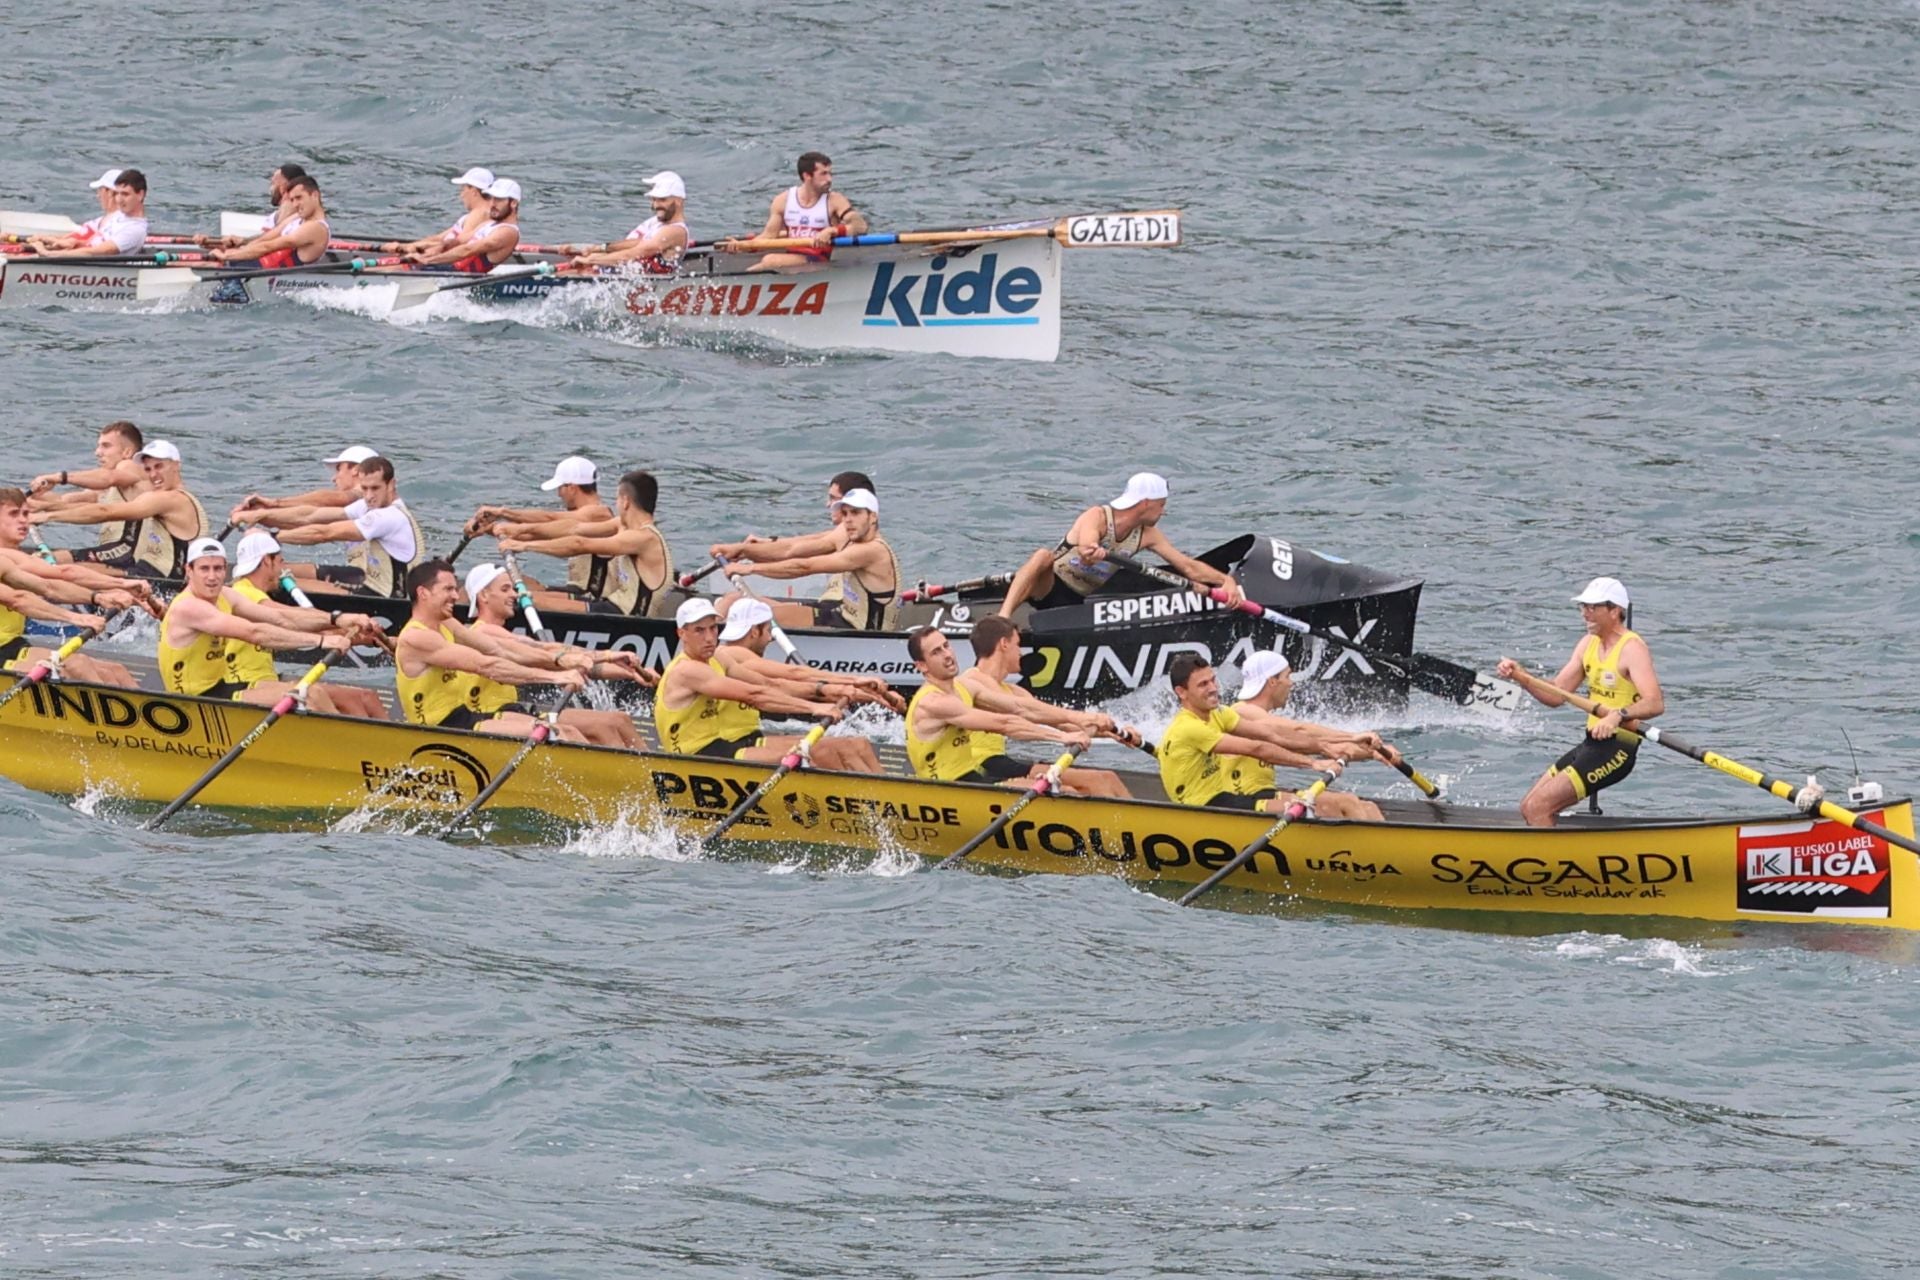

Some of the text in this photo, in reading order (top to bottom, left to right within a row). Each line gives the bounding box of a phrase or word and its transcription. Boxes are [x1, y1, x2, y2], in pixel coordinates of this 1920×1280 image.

[865, 250, 1043, 327] kide
[96, 731, 119, 749] By
[1587, 750, 1629, 784] ORIALKI
[652, 771, 769, 815] PBX
[830, 817, 939, 841] GRUP
[1794, 835, 1875, 857] EUSKO LABEL
[1431, 853, 1694, 885] SAGARDI
[1794, 849, 1877, 876] LIGA
[1467, 885, 1534, 897] Euskal
